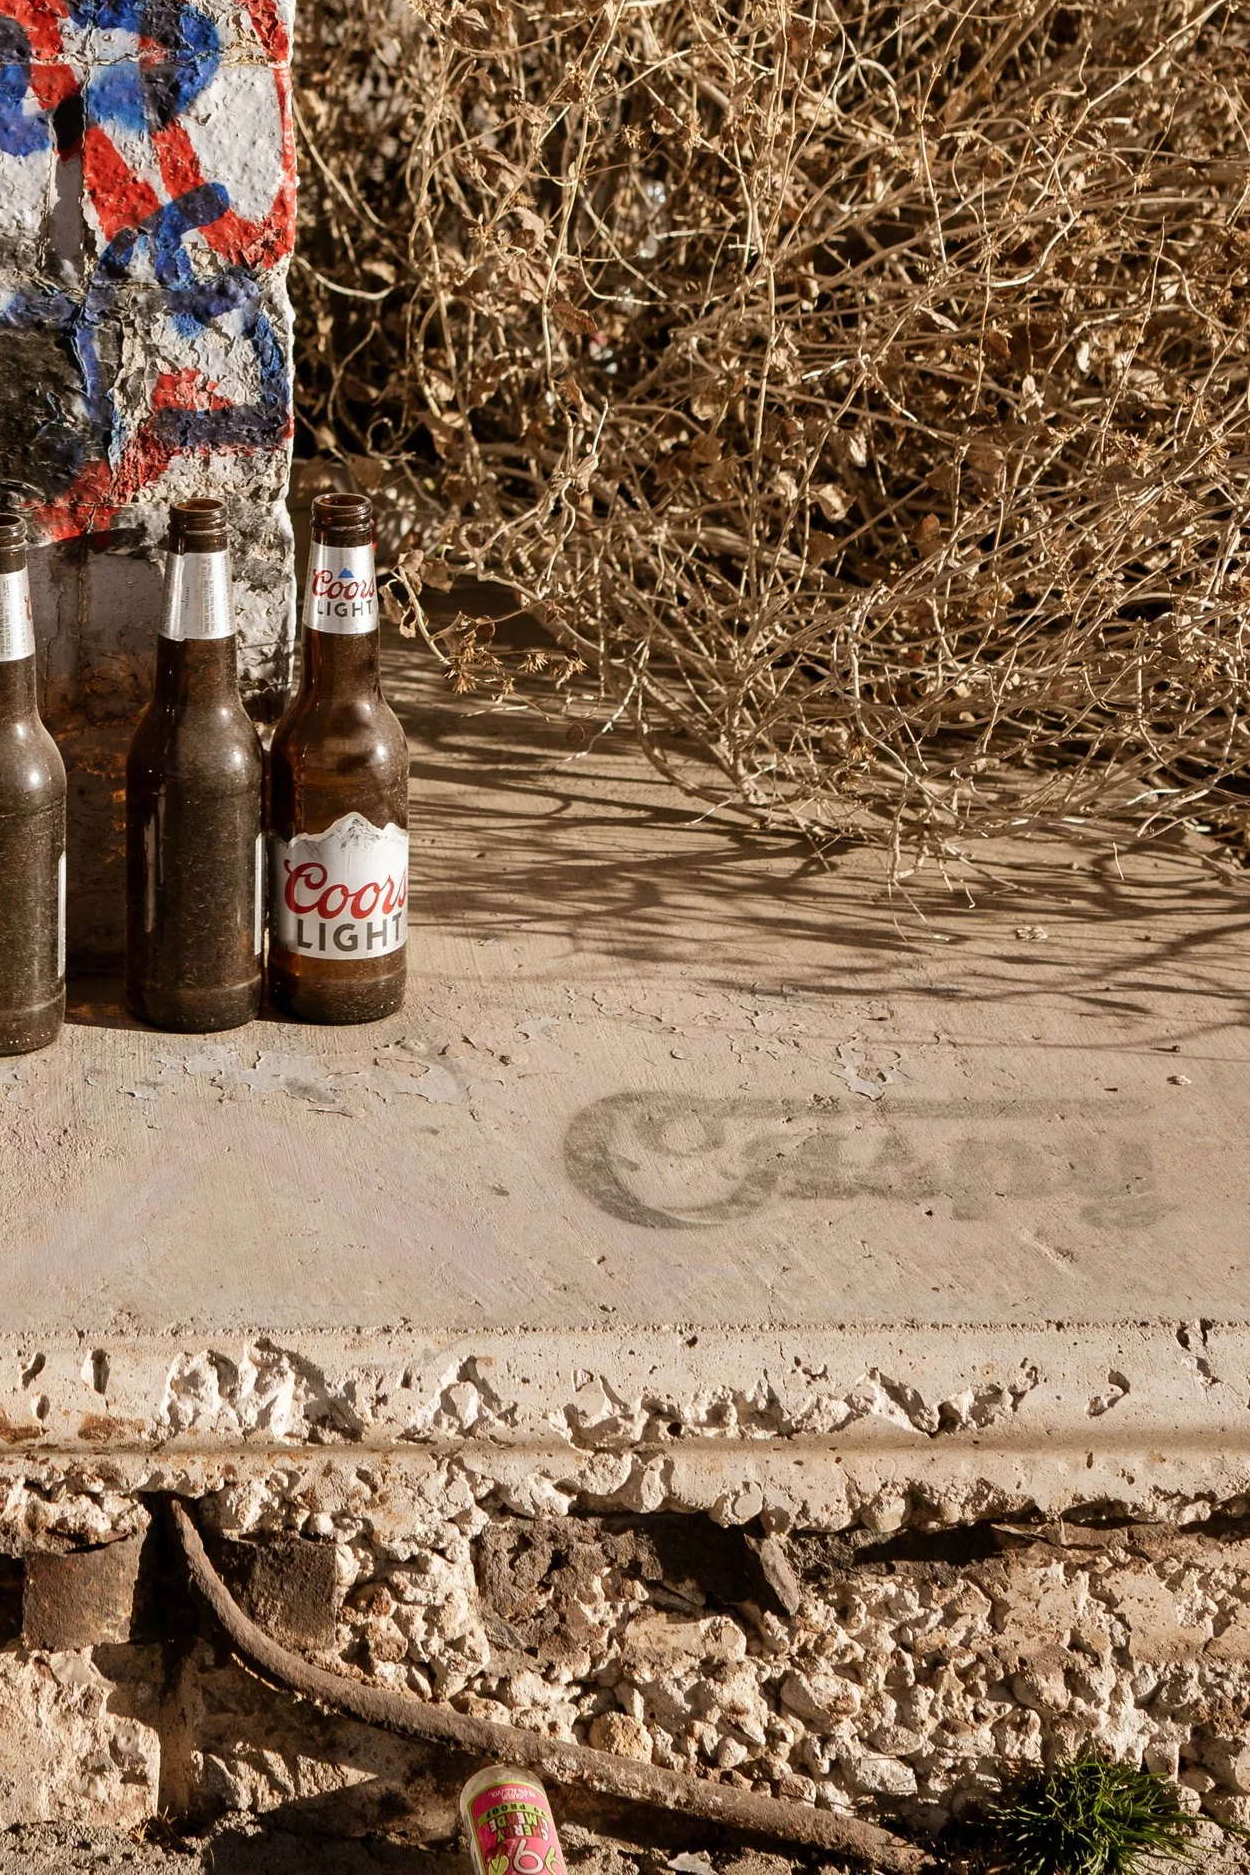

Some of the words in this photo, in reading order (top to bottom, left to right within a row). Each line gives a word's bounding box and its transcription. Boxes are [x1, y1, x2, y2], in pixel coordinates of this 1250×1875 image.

[312, 568, 376, 601] Coors
[317, 600, 373, 618] LIGHT
[486, 1804, 526, 1819] PROOF
